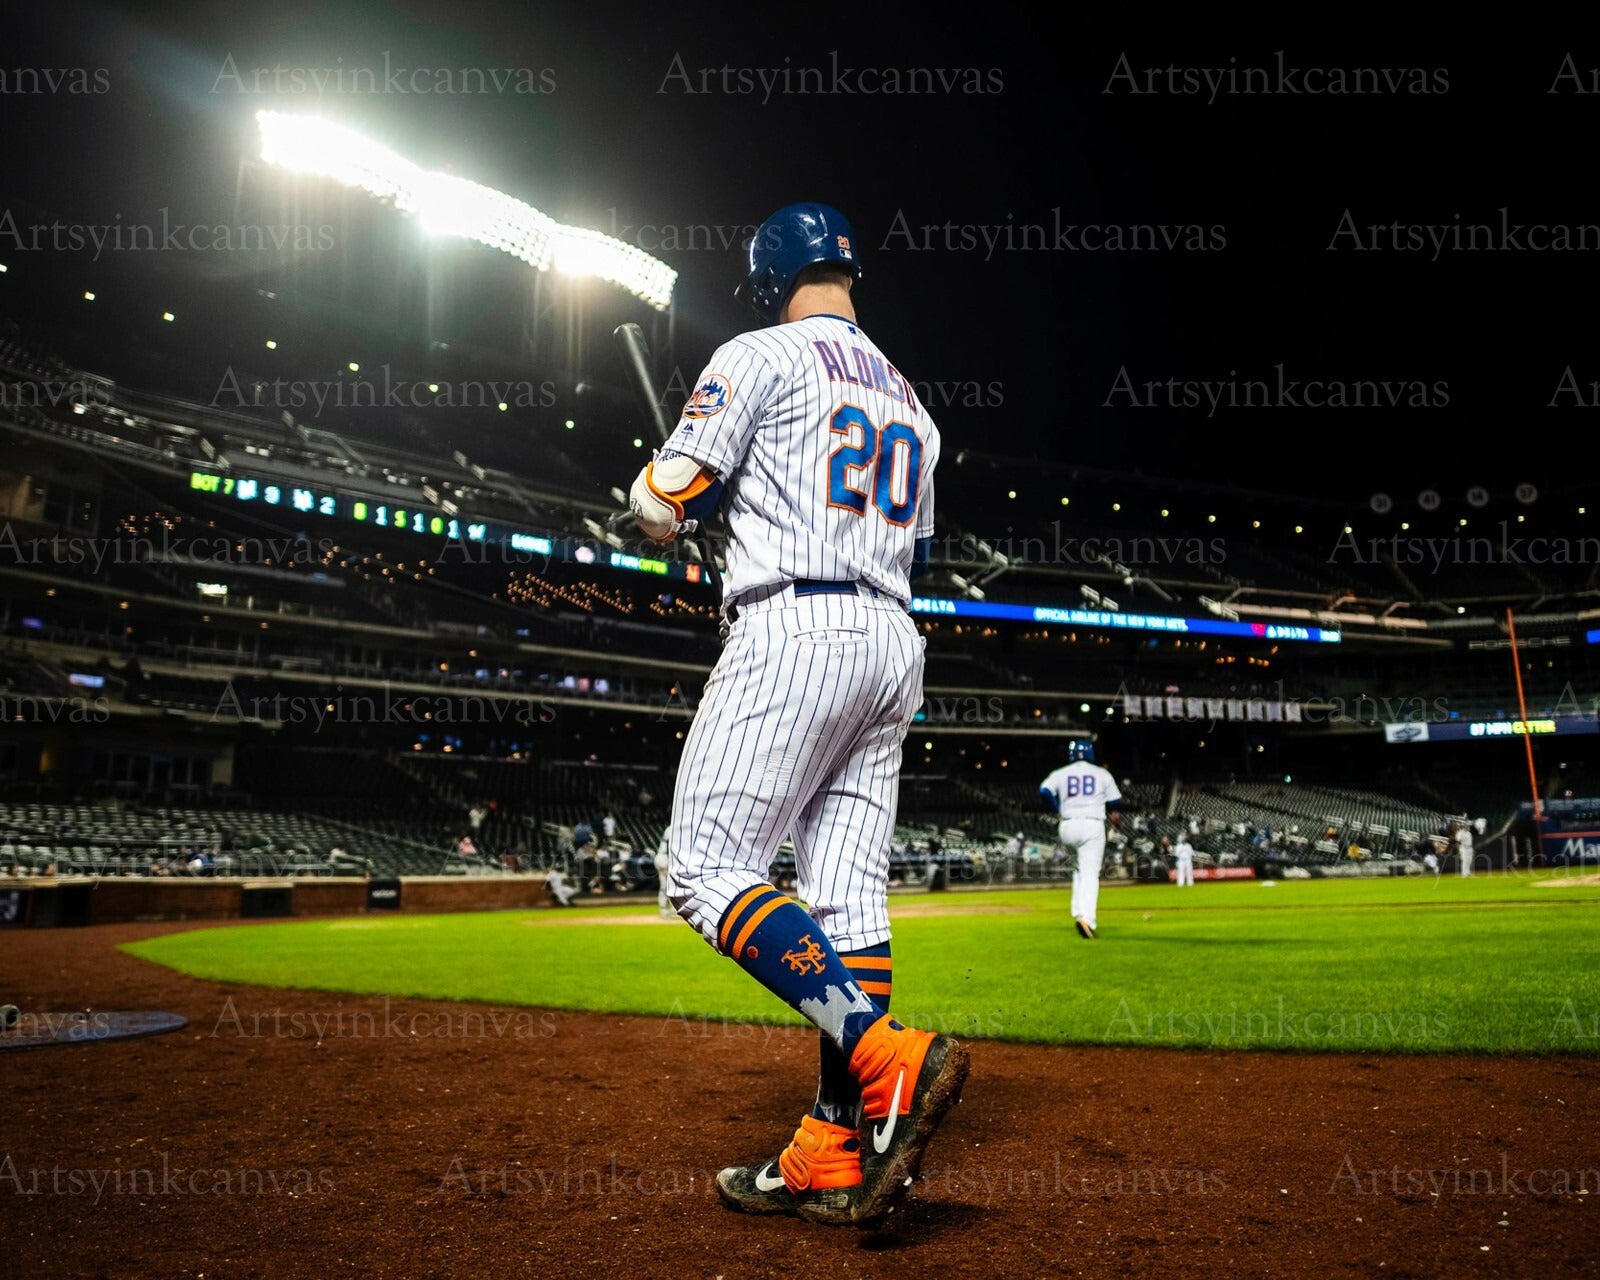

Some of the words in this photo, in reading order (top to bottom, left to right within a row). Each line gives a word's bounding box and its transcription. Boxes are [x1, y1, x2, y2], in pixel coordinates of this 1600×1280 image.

[827, 401, 923, 528] 20
[191, 473, 220, 492] BOT
[224, 478, 235, 494] 7
[320, 496, 336, 515] 2
[375, 506, 388, 526] 1
[413, 513, 424, 533] 1
[448, 520, 459, 539] 1
[912, 598, 956, 613] DELTA
[1035, 607, 1070, 621] OFFICIAL
[1112, 614, 1126, 626] THE
[1128, 615, 1145, 627] NEW
[1146, 617, 1165, 629] YORK
[1277, 626, 1309, 639] DELTA
[1468, 636, 1573, 650] PORSCHE
[1486, 722, 1512, 735] MPH
